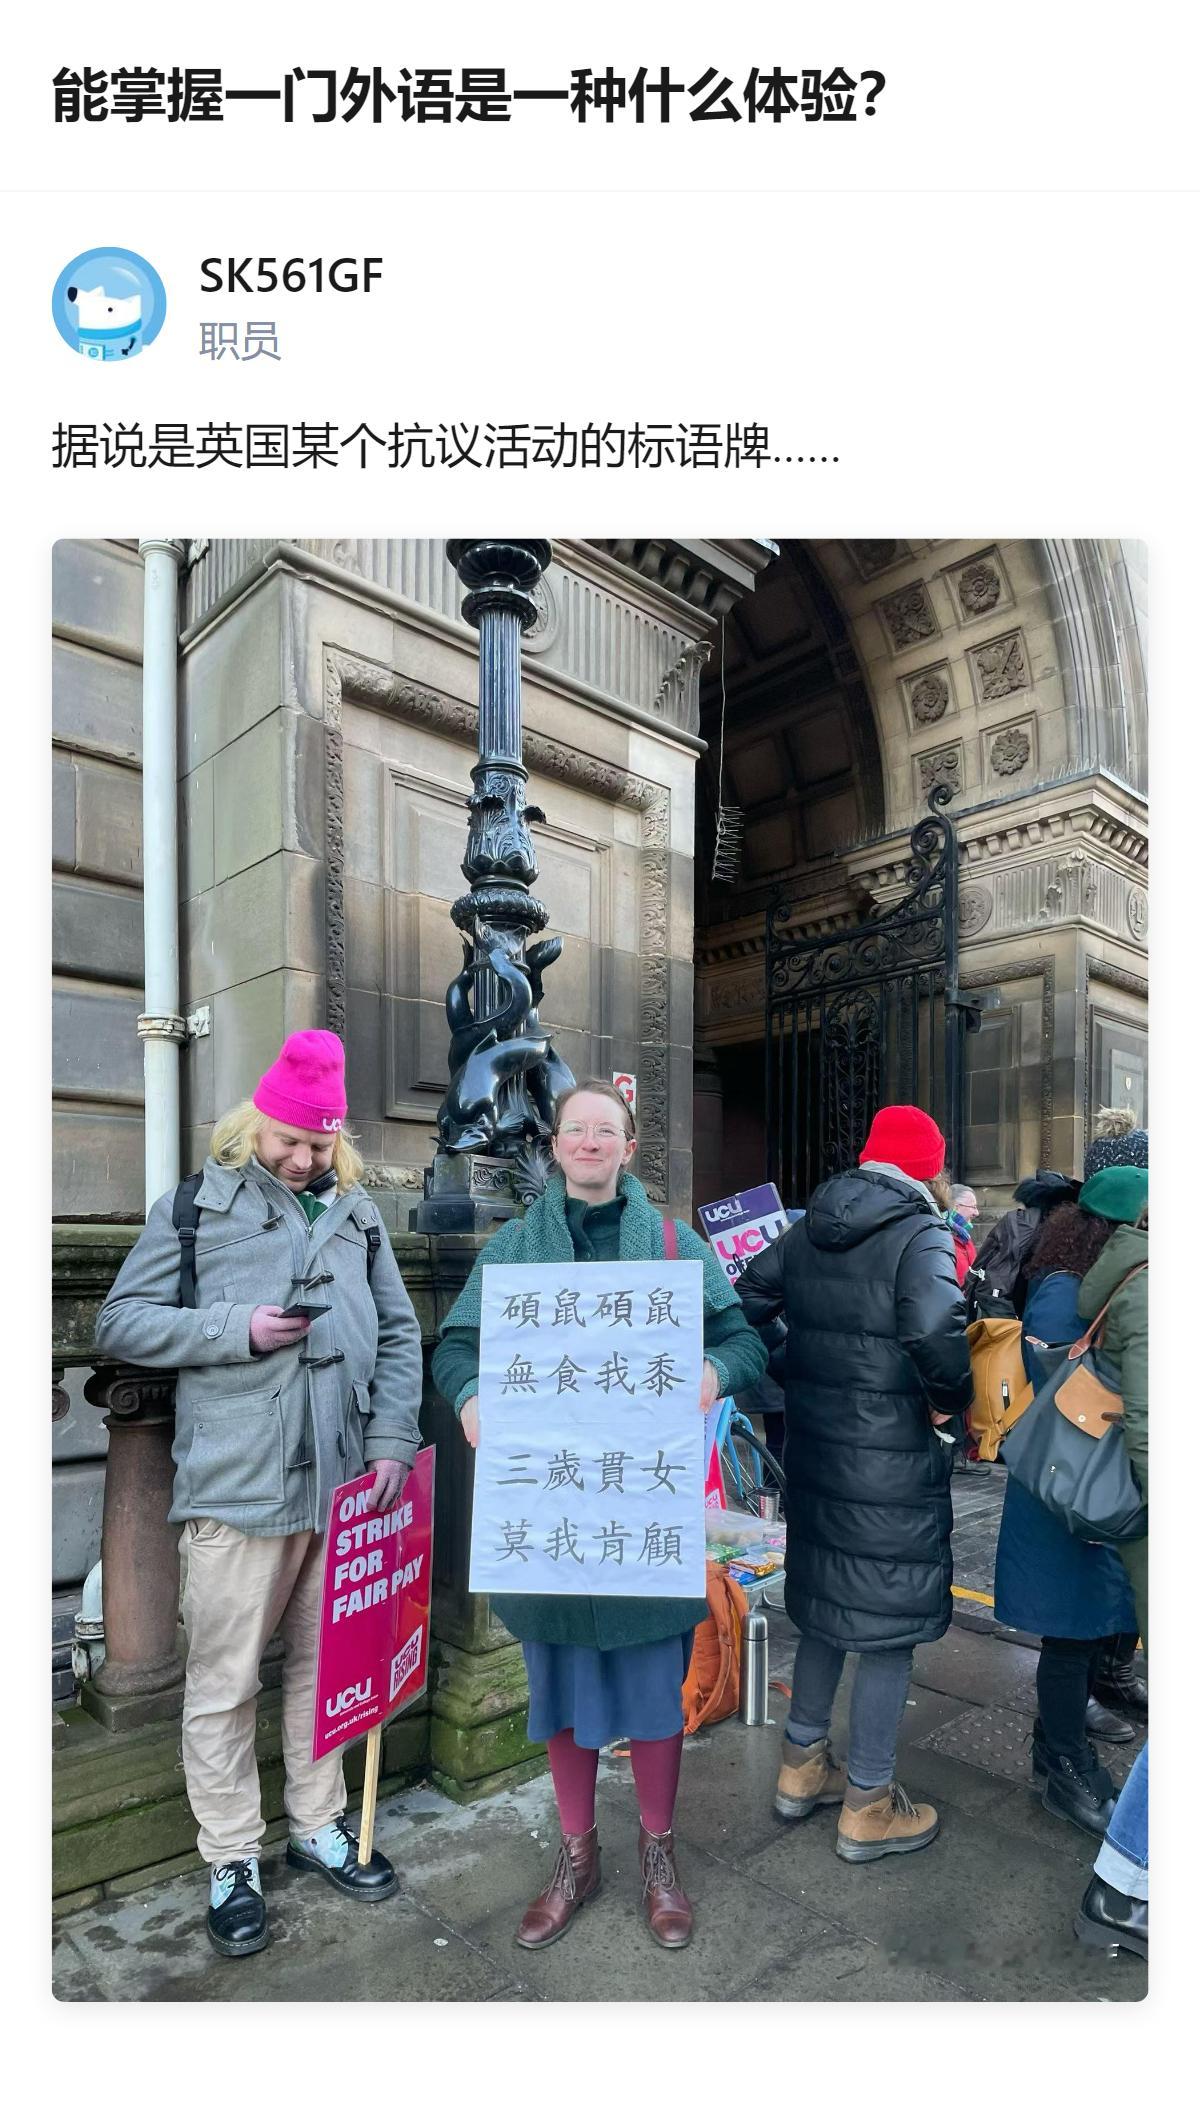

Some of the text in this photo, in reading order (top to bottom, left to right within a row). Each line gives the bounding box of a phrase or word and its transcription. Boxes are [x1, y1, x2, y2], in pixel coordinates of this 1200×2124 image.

[705, 1200, 742, 1222] UCU
[501, 1287, 681, 1329] 碩鼠碩鼠
[499, 1350, 687, 1398] 無食我黍
[496, 1449, 687, 1495] 三歲貫女
[335, 1501, 413, 1557] STRIKE
[494, 1517, 683, 1567] 莫我肯顧
[332, 1553, 424, 1624] FAIR PAY
[334, 1549, 384, 1591] FOR
[326, 1677, 372, 1718] UCU
[324, 1705, 379, 1740] ucu.org.uk/rising
